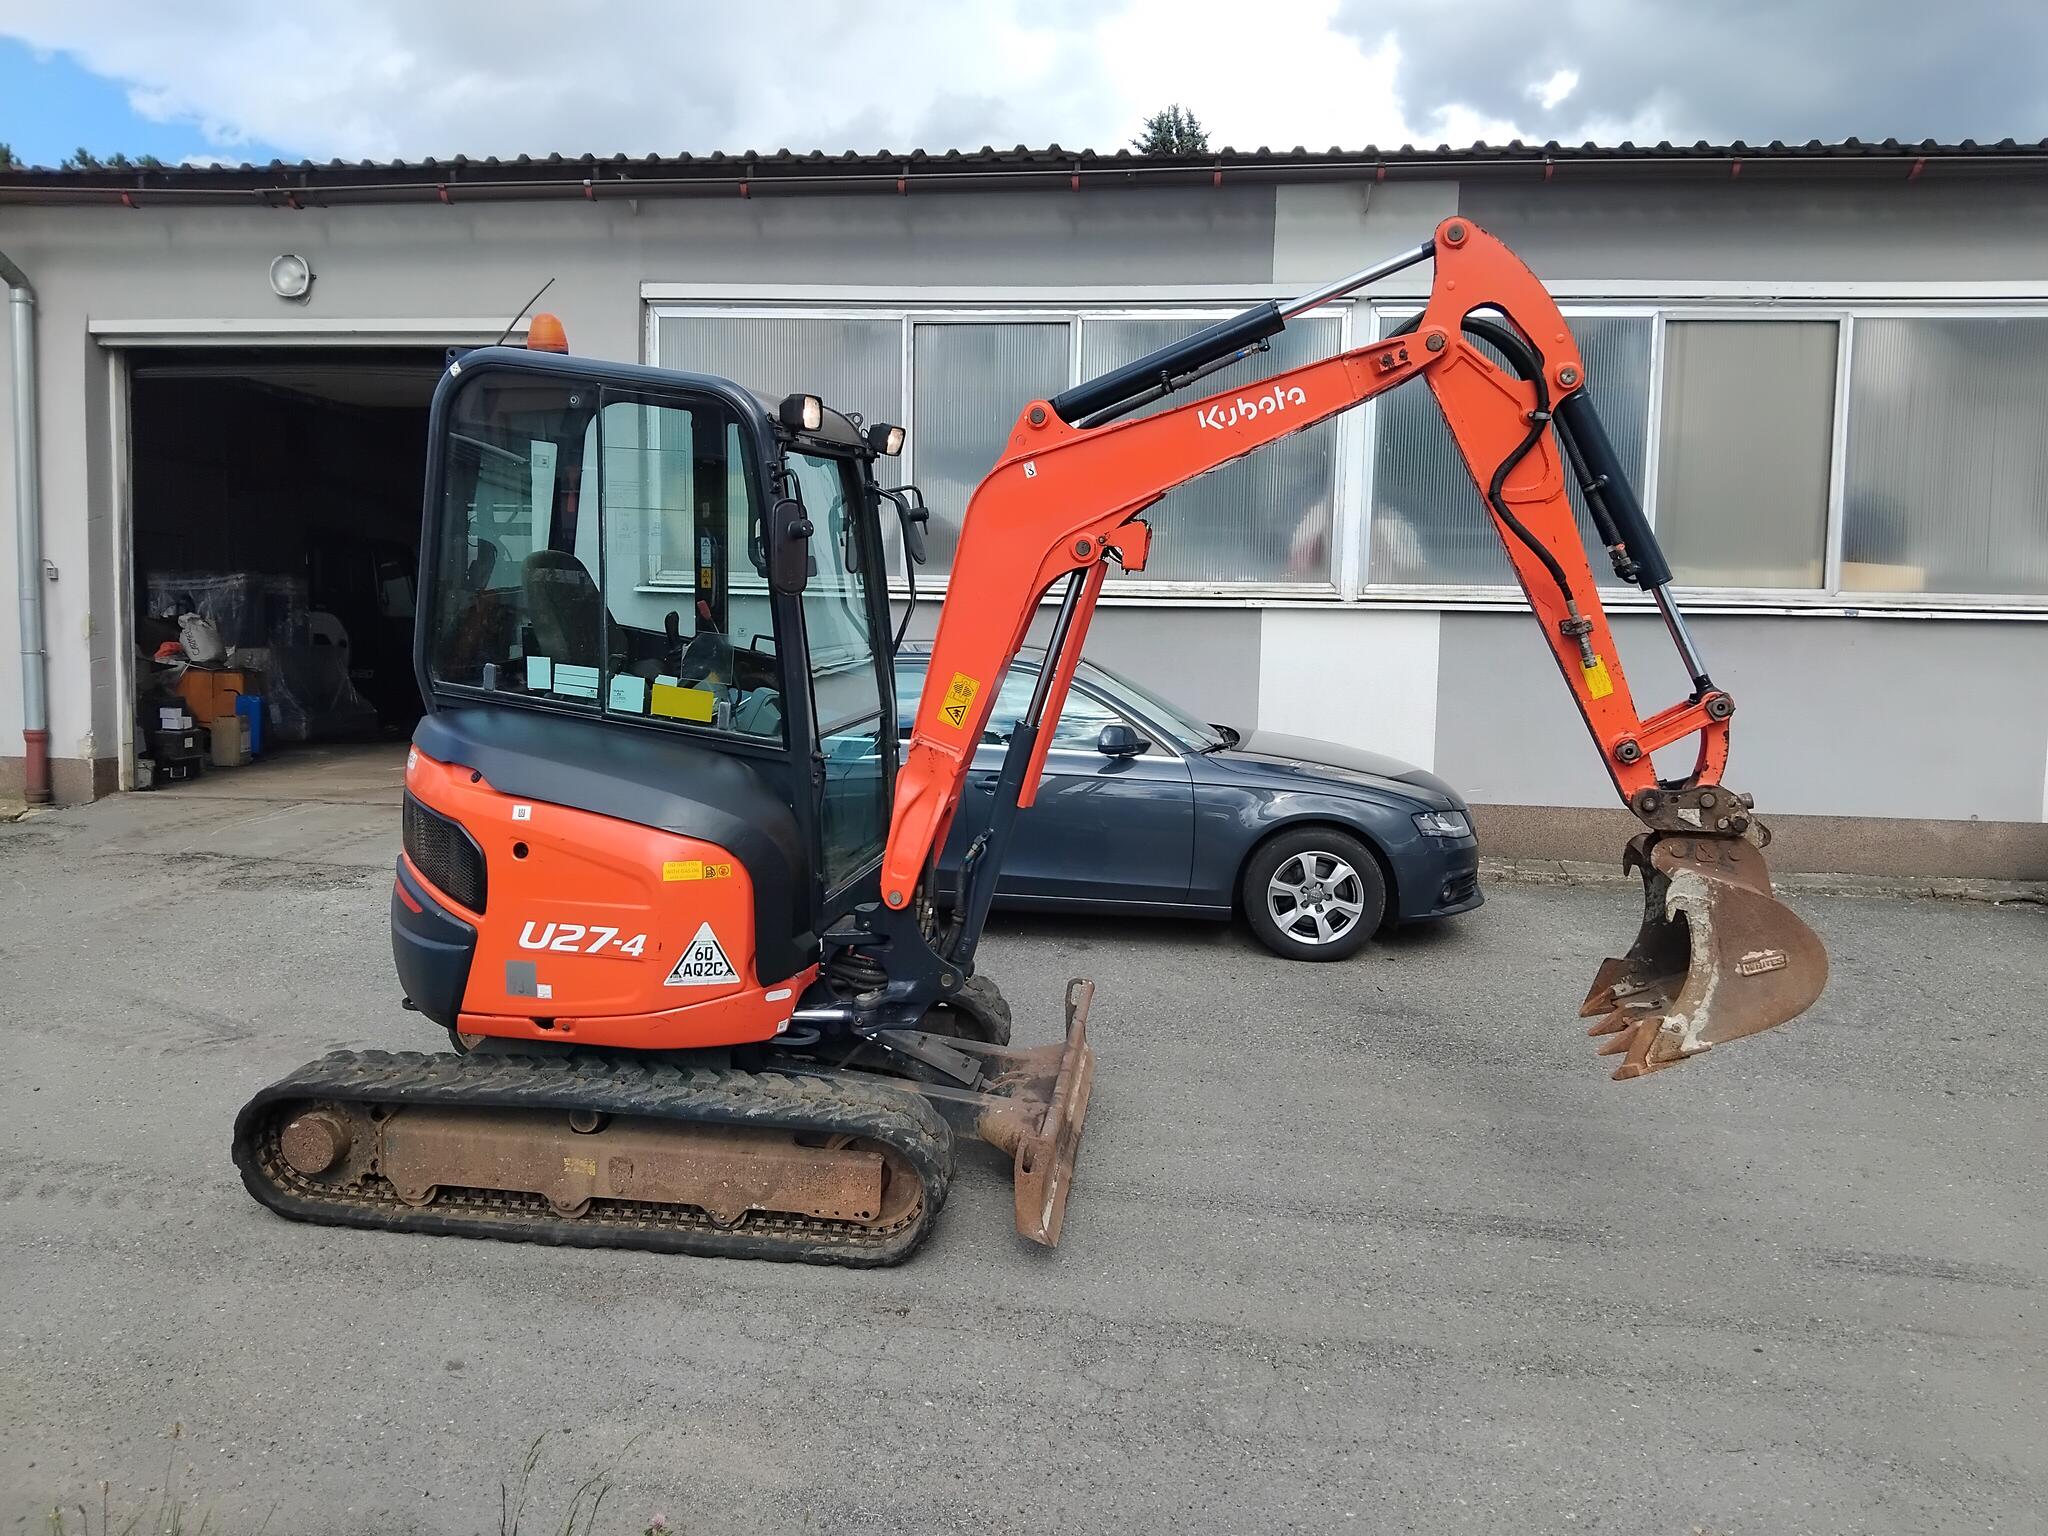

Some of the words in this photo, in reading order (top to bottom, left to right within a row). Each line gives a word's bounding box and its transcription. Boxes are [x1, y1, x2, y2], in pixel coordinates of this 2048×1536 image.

[1197, 385, 1306, 429] Kubota
[518, 921, 647, 956] U27-4
[683, 962, 724, 977] AQ2C
